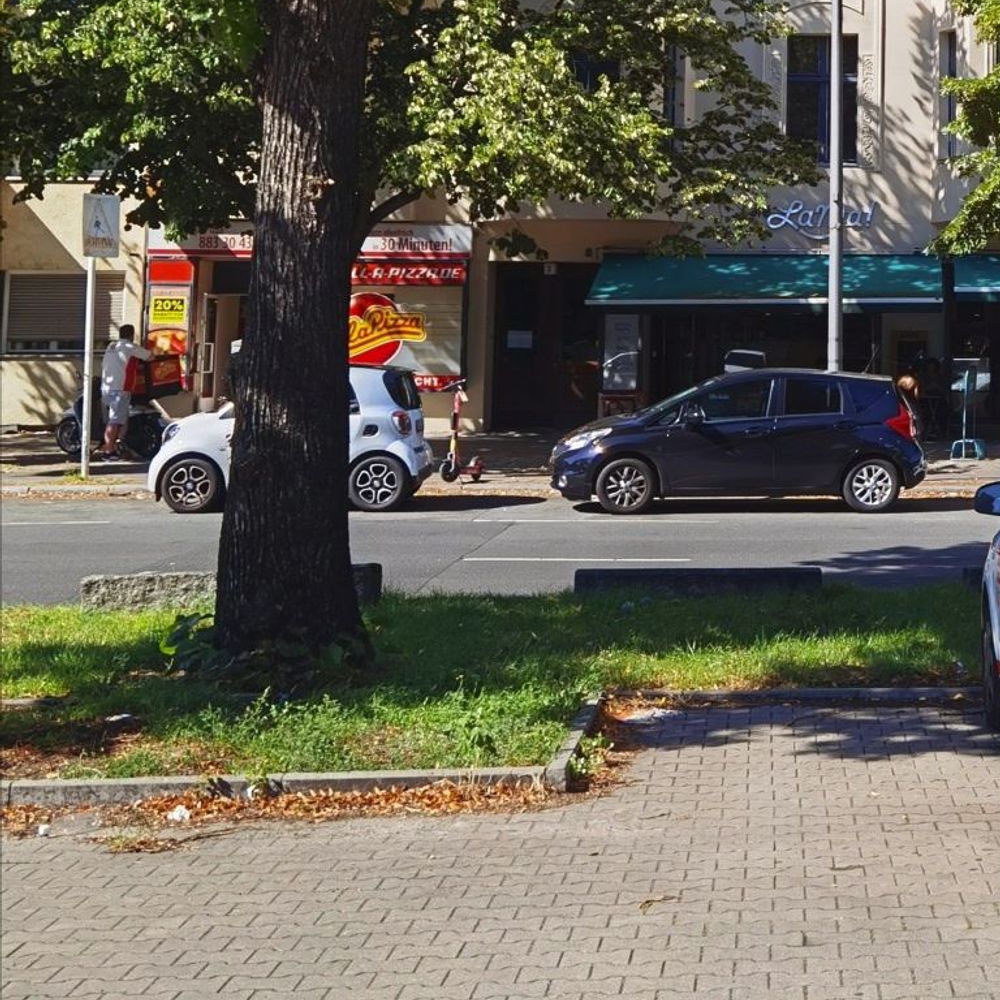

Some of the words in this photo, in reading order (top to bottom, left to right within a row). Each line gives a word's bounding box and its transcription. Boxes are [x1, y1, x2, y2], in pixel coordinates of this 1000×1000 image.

[380, 238, 395, 251] 30
[398, 237, 453, 251] Minuten!
[351, 266, 462, 279] LL-A-PIZZA.DE
[154, 299, 185, 311] 20%
